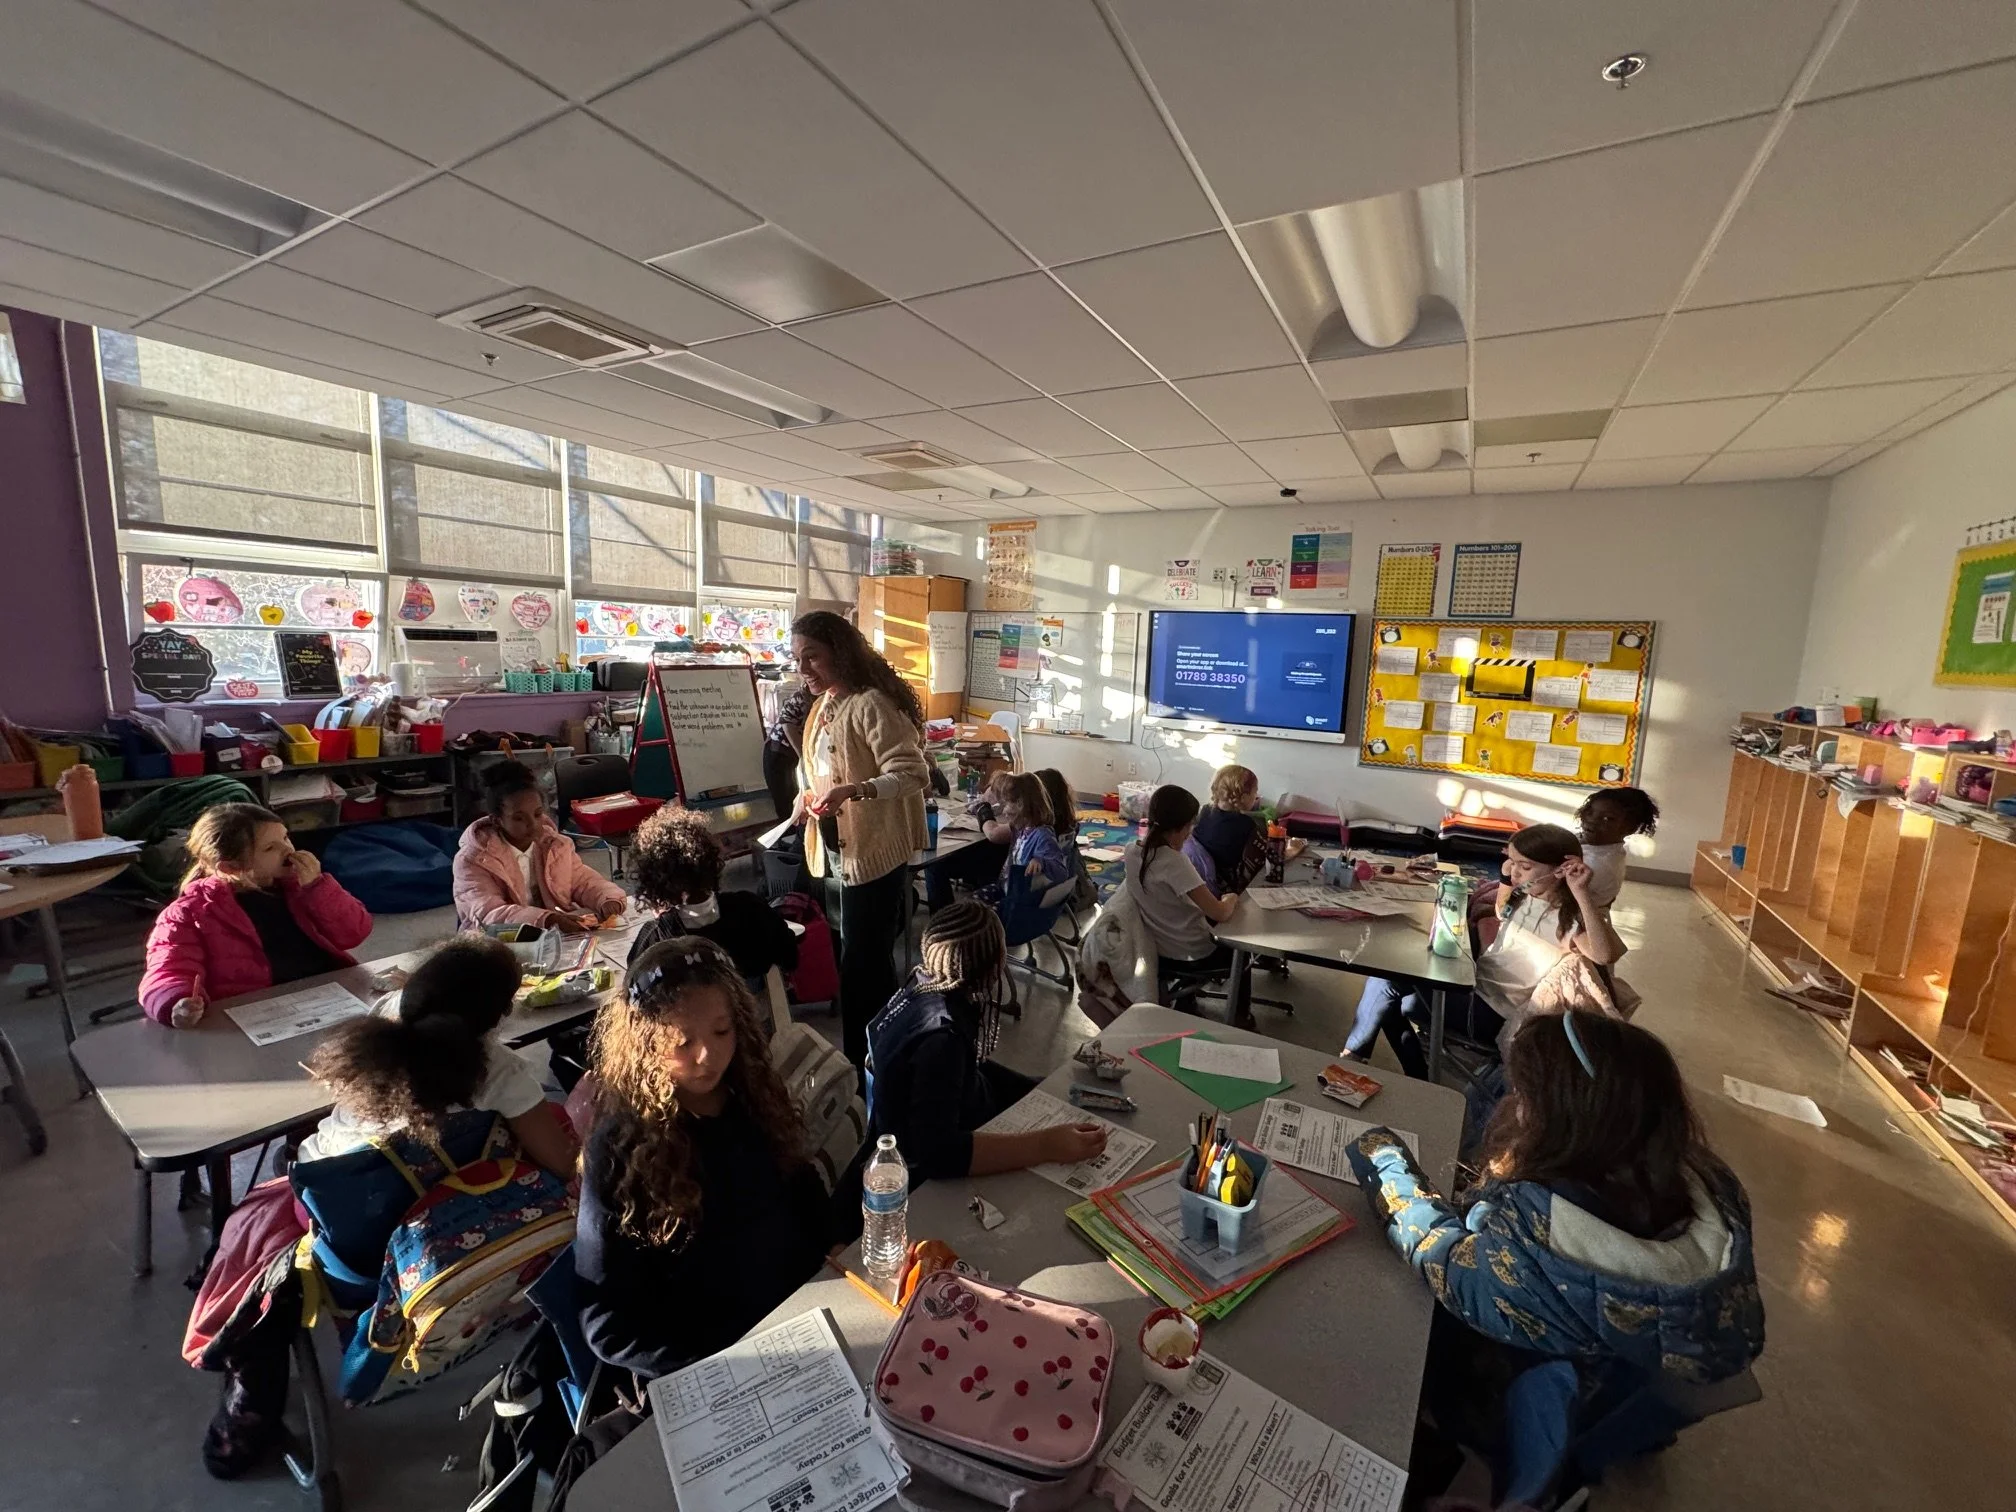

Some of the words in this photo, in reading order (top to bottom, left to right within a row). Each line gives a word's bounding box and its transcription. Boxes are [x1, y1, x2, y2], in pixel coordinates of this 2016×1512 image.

[1167, 568, 1196, 576] CELEBRATE
[1252, 567, 1277, 578] LEARN
[160, 641, 181, 649] YAY
[1176, 671, 1207, 681] 01789
[1210, 672, 1246, 684] 38350
[832, 1386, 854, 1402] What
[791, 1405, 819, 1424] Need?
[845, 1425, 872, 1445] Goals
[1111, 1425, 1139, 1460] Budget
[1131, 1398, 1155, 1430] Builder
[1248, 1445, 1264, 1466] What
[1263, 1411, 1280, 1436] Want?
[742, 1432, 767, 1450] What
[829, 1440, 845, 1454] for
[693, 1453, 726, 1475] Want?
[794, 1447, 830, 1473] Today:
[1159, 1480, 1179, 1509] Goals
[1173, 1467, 1187, 1484] for
[1181, 1440, 1204, 1472] Today:
[846, 1479, 886, 1511] Budget
[1226, 1483, 1245, 1511] Need?
